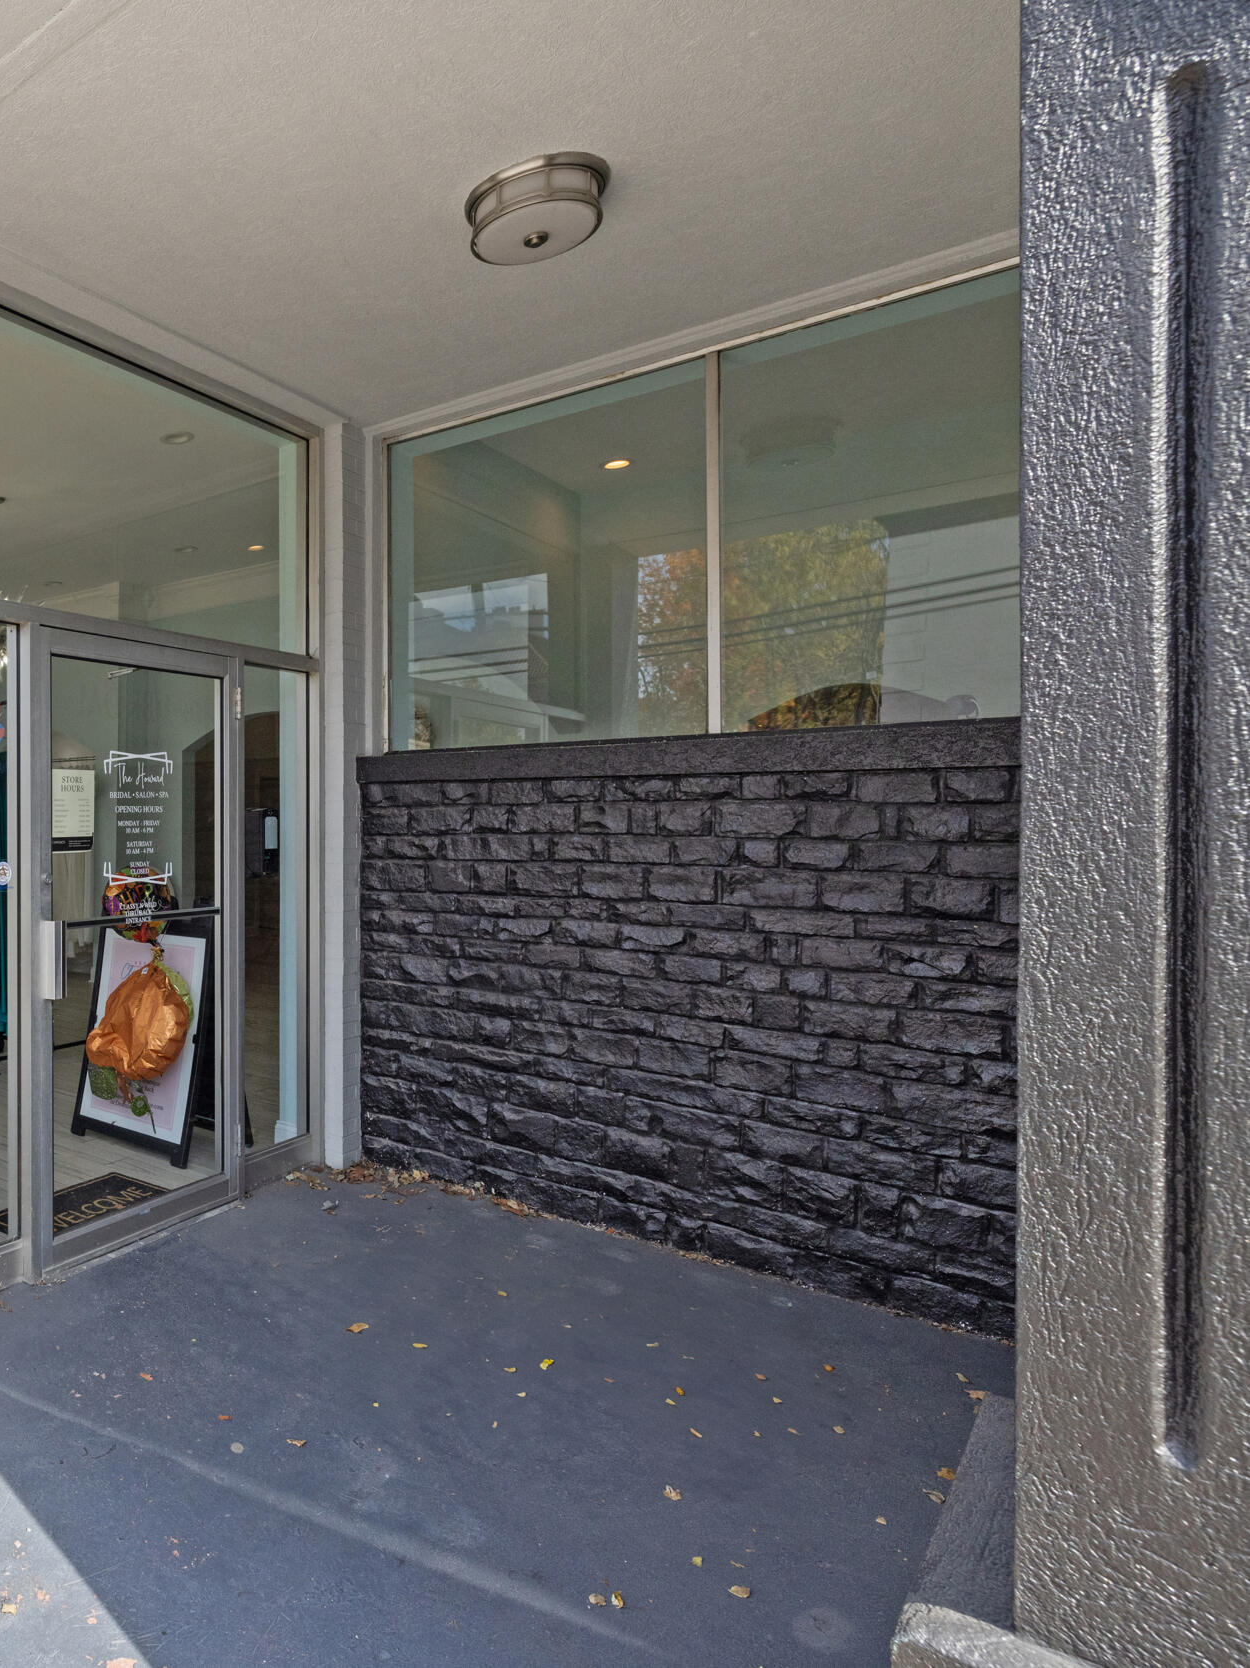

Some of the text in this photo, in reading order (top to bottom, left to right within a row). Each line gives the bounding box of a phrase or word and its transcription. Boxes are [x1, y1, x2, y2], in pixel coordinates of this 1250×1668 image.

[61, 775, 84, 783] STORE
[113, 761, 166, 789] The Howard
[60, 784, 85, 792] HOURS
[114, 805, 163, 813] OPENING HOURS
[126, 840, 153, 848] SATURDAY
[125, 916, 152, 925] ENTRANCE
